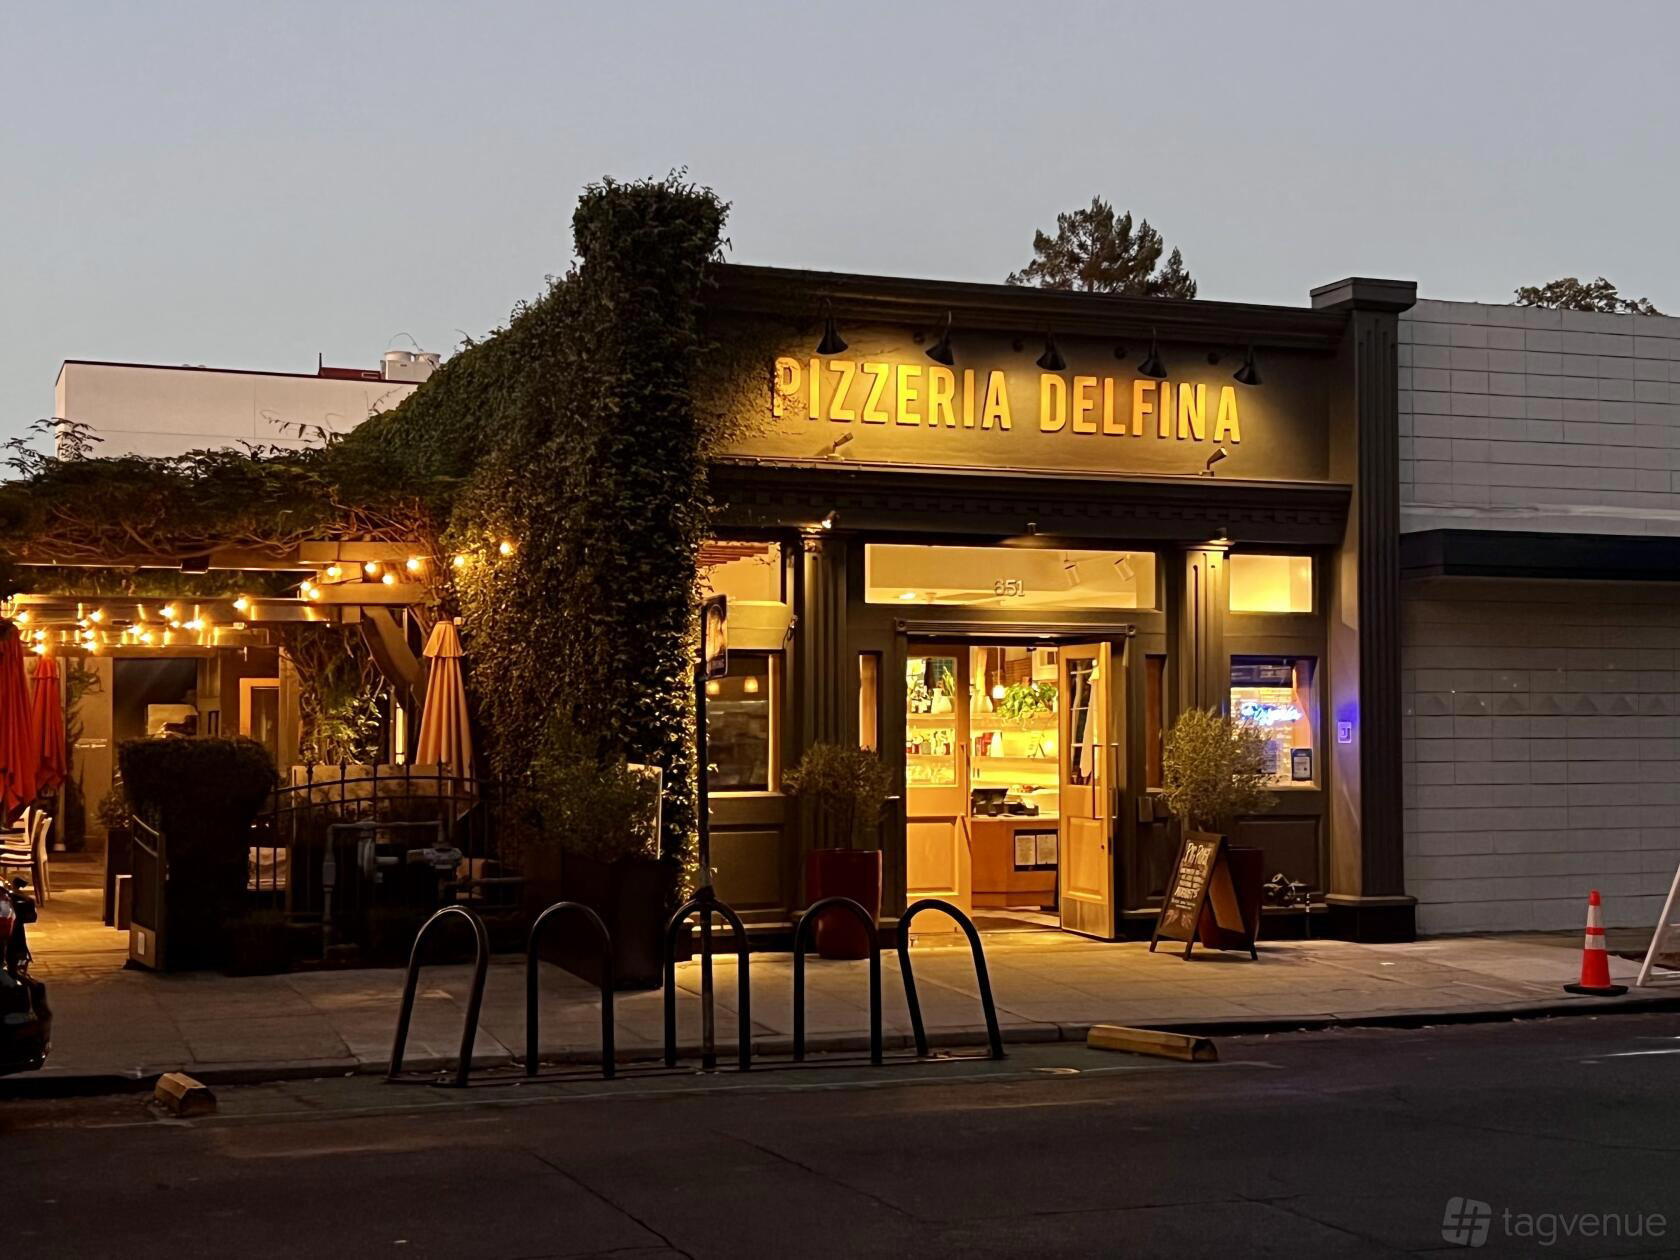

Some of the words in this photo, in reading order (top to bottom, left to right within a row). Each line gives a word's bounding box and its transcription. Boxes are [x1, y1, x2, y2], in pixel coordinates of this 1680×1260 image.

[772, 357, 1012, 430] PIZZERIA
[1040, 373, 1241, 443] DELFINA
[993, 578, 1025, 597] 651
